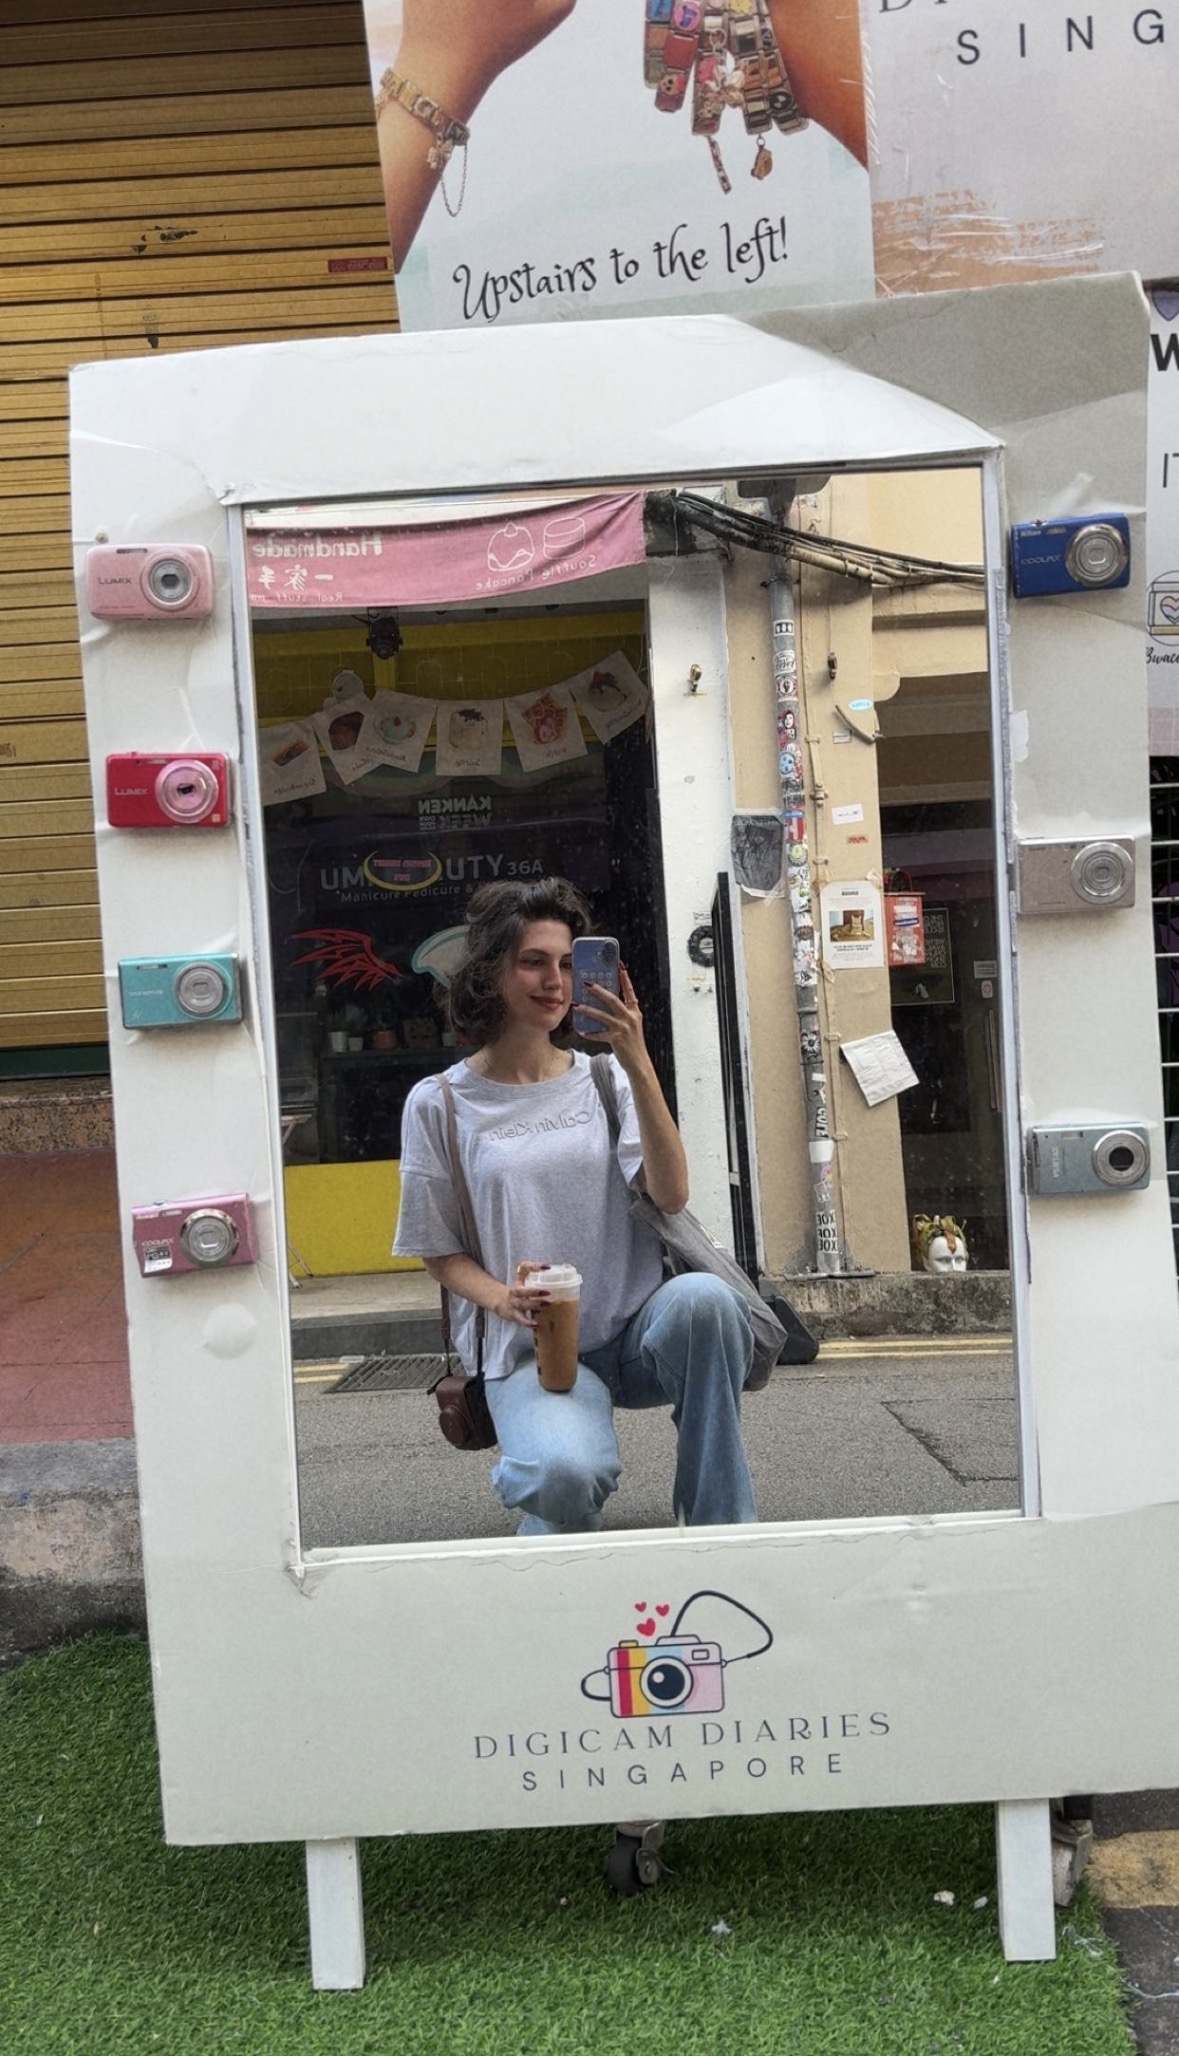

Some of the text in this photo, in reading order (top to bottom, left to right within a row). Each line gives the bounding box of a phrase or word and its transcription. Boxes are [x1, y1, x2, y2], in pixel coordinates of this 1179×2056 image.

[452, 216, 788, 323] Upstairs to the left!
[97, 577, 133, 585] LUMIX
[114, 787, 149, 796] LUMIX
[438, 853, 504, 883] UTY
[508, 858, 544, 876] 36A
[341, 887, 400, 903] Manicure
[474, 1712, 891, 1759] DIGICAM DIARIES
[522, 1753, 842, 1791] SINGAPORE
